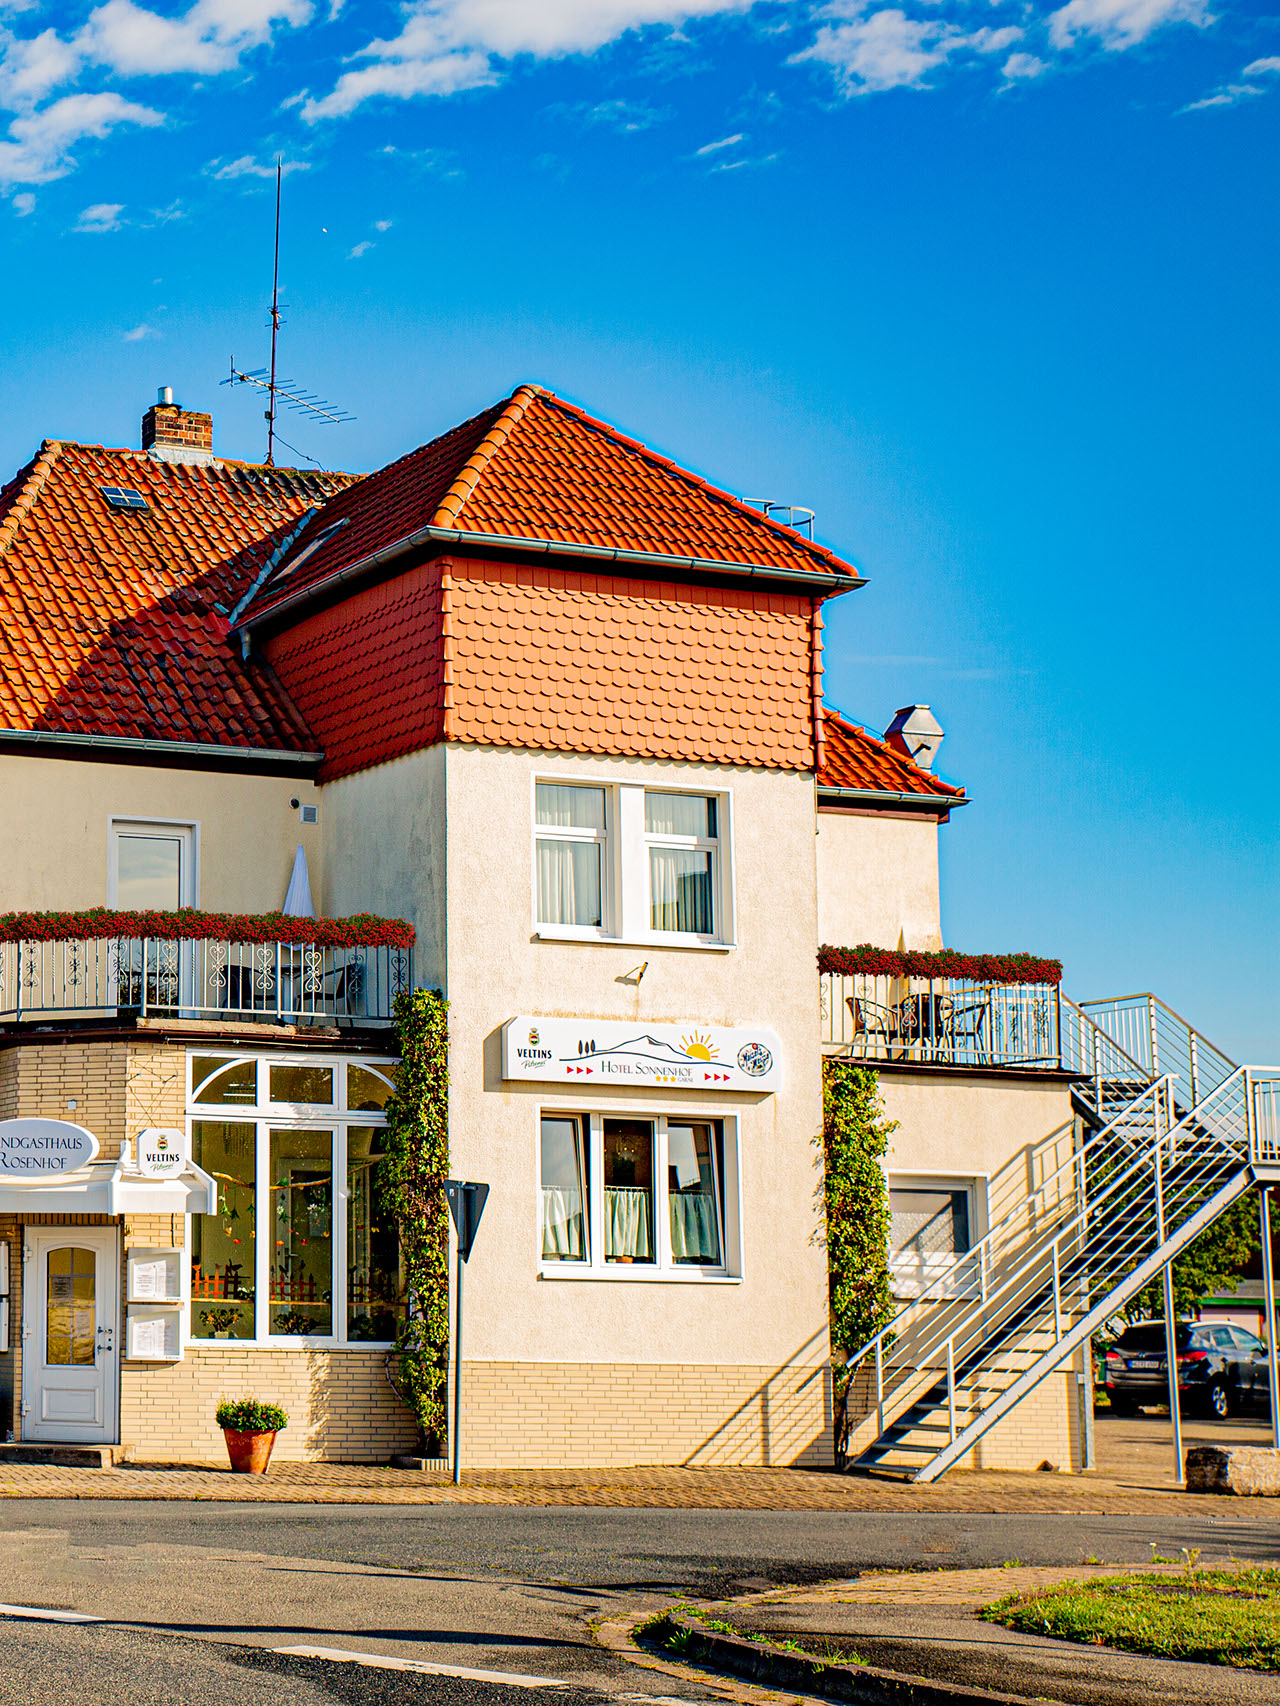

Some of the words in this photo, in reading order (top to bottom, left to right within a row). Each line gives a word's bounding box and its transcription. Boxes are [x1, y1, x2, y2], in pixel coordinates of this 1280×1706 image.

[517, 1048, 552, 1059] VELTINS
[601, 1060, 634, 1074] HOTEL
[635, 1062, 694, 1077] SONNENHOF
[146, 1153, 180, 1162] VELTINS
